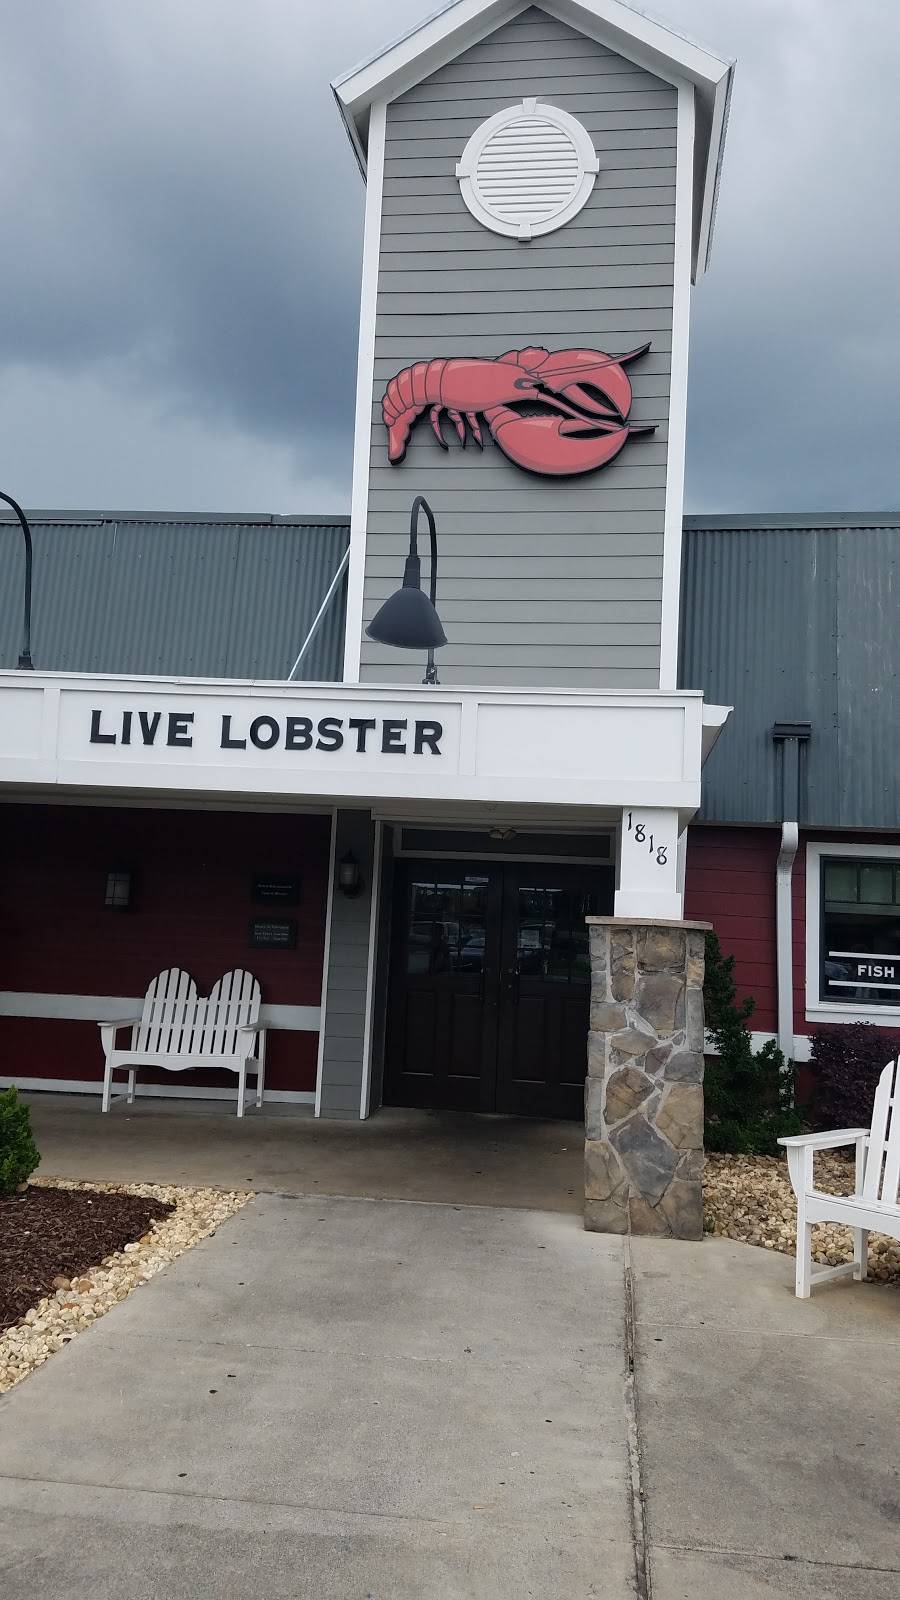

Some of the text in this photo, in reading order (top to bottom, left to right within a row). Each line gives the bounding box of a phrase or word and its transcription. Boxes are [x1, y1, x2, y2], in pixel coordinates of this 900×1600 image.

[90, 710, 443, 755] LIVE LOBSTER
[627, 812, 668, 865] 1818
[857, 964, 895, 978] FISH
